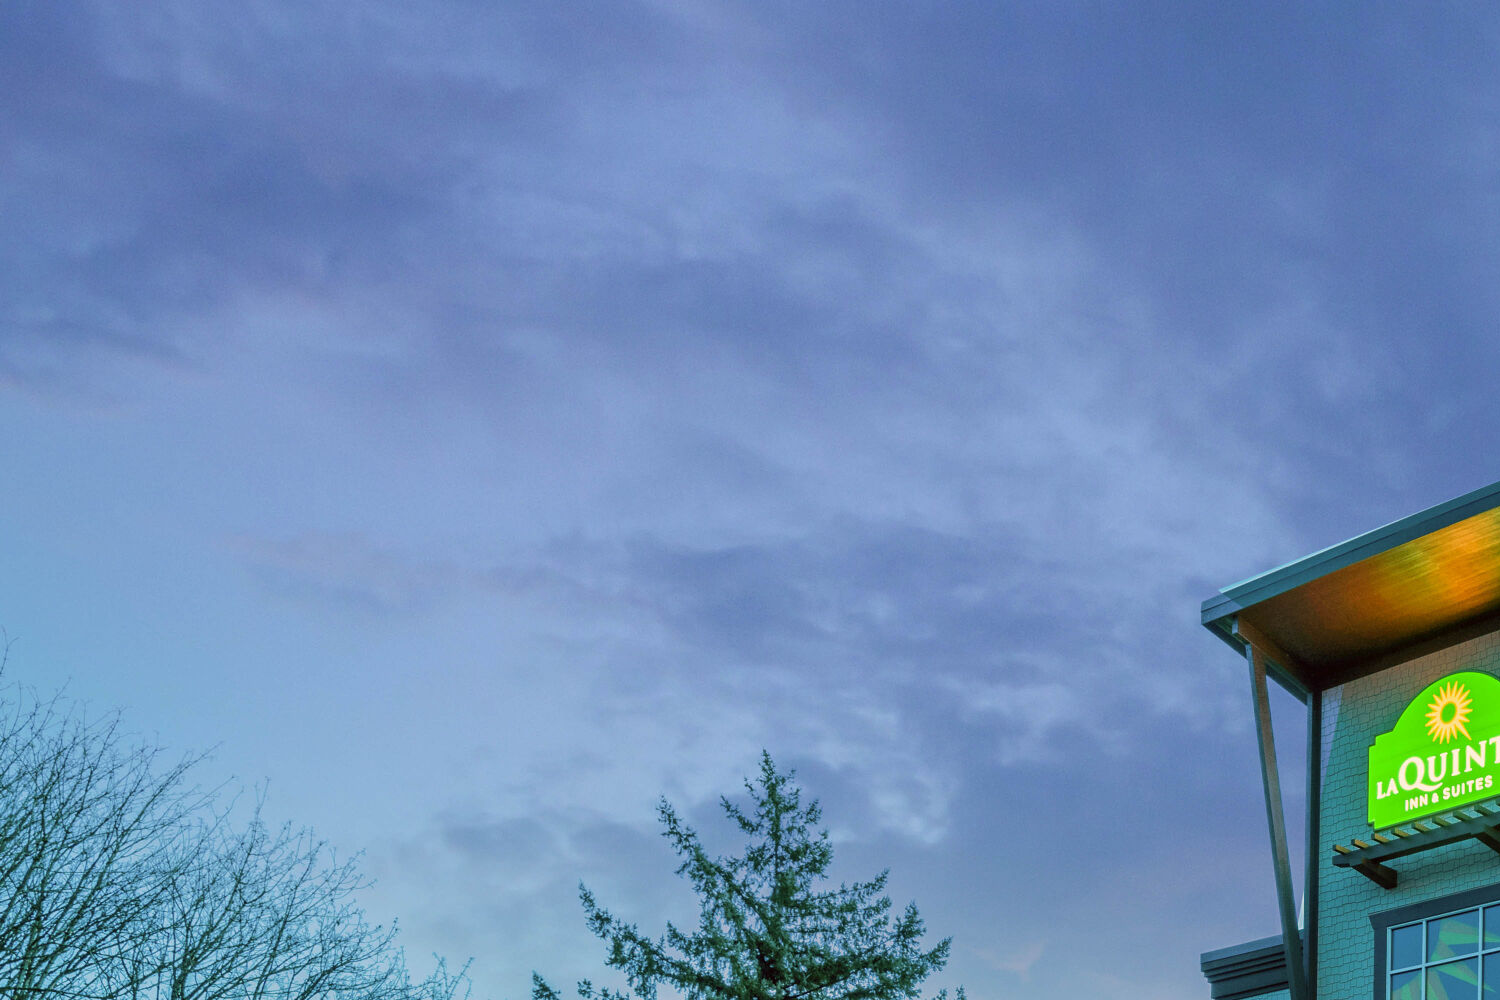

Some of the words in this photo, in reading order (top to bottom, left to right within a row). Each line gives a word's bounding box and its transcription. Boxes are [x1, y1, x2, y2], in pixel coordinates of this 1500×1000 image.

[1405, 794, 1428, 811] INN
[1431, 794, 1439, 804] &
[1443, 775, 1493, 800] SUITES
